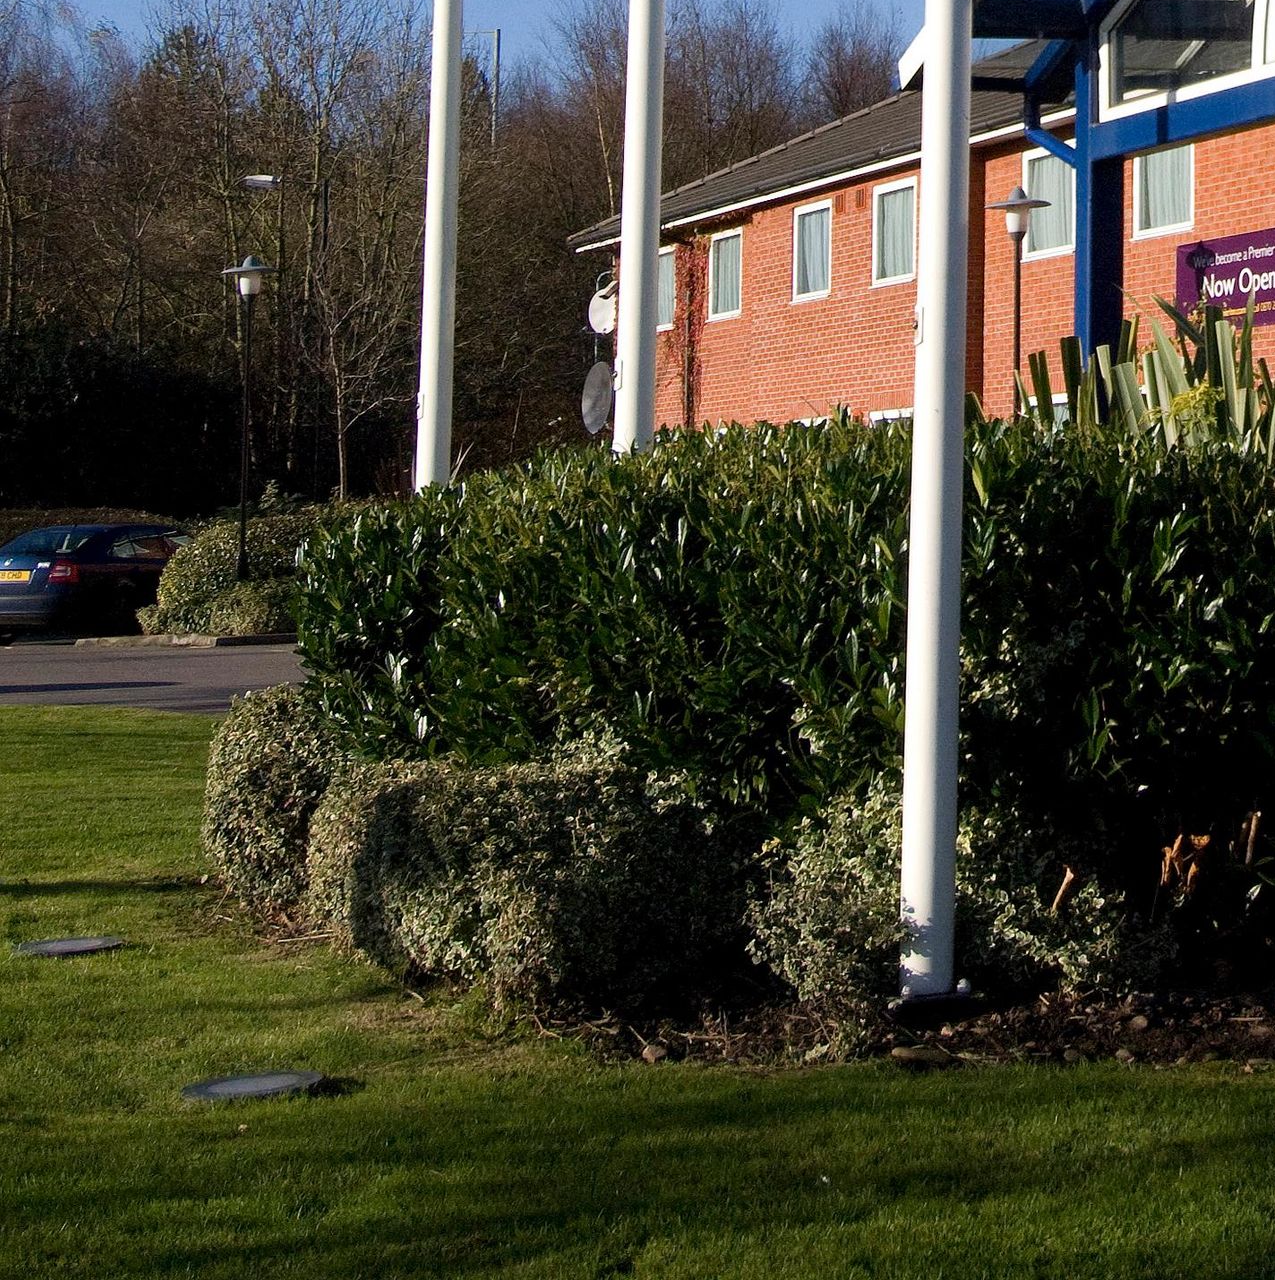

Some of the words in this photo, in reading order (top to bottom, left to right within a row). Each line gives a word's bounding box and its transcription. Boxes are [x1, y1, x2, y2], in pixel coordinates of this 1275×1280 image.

[1215, 252, 1243, 266] become
[1248, 243, 1275, 260] Premier
[1202, 273, 1236, 299] Now
